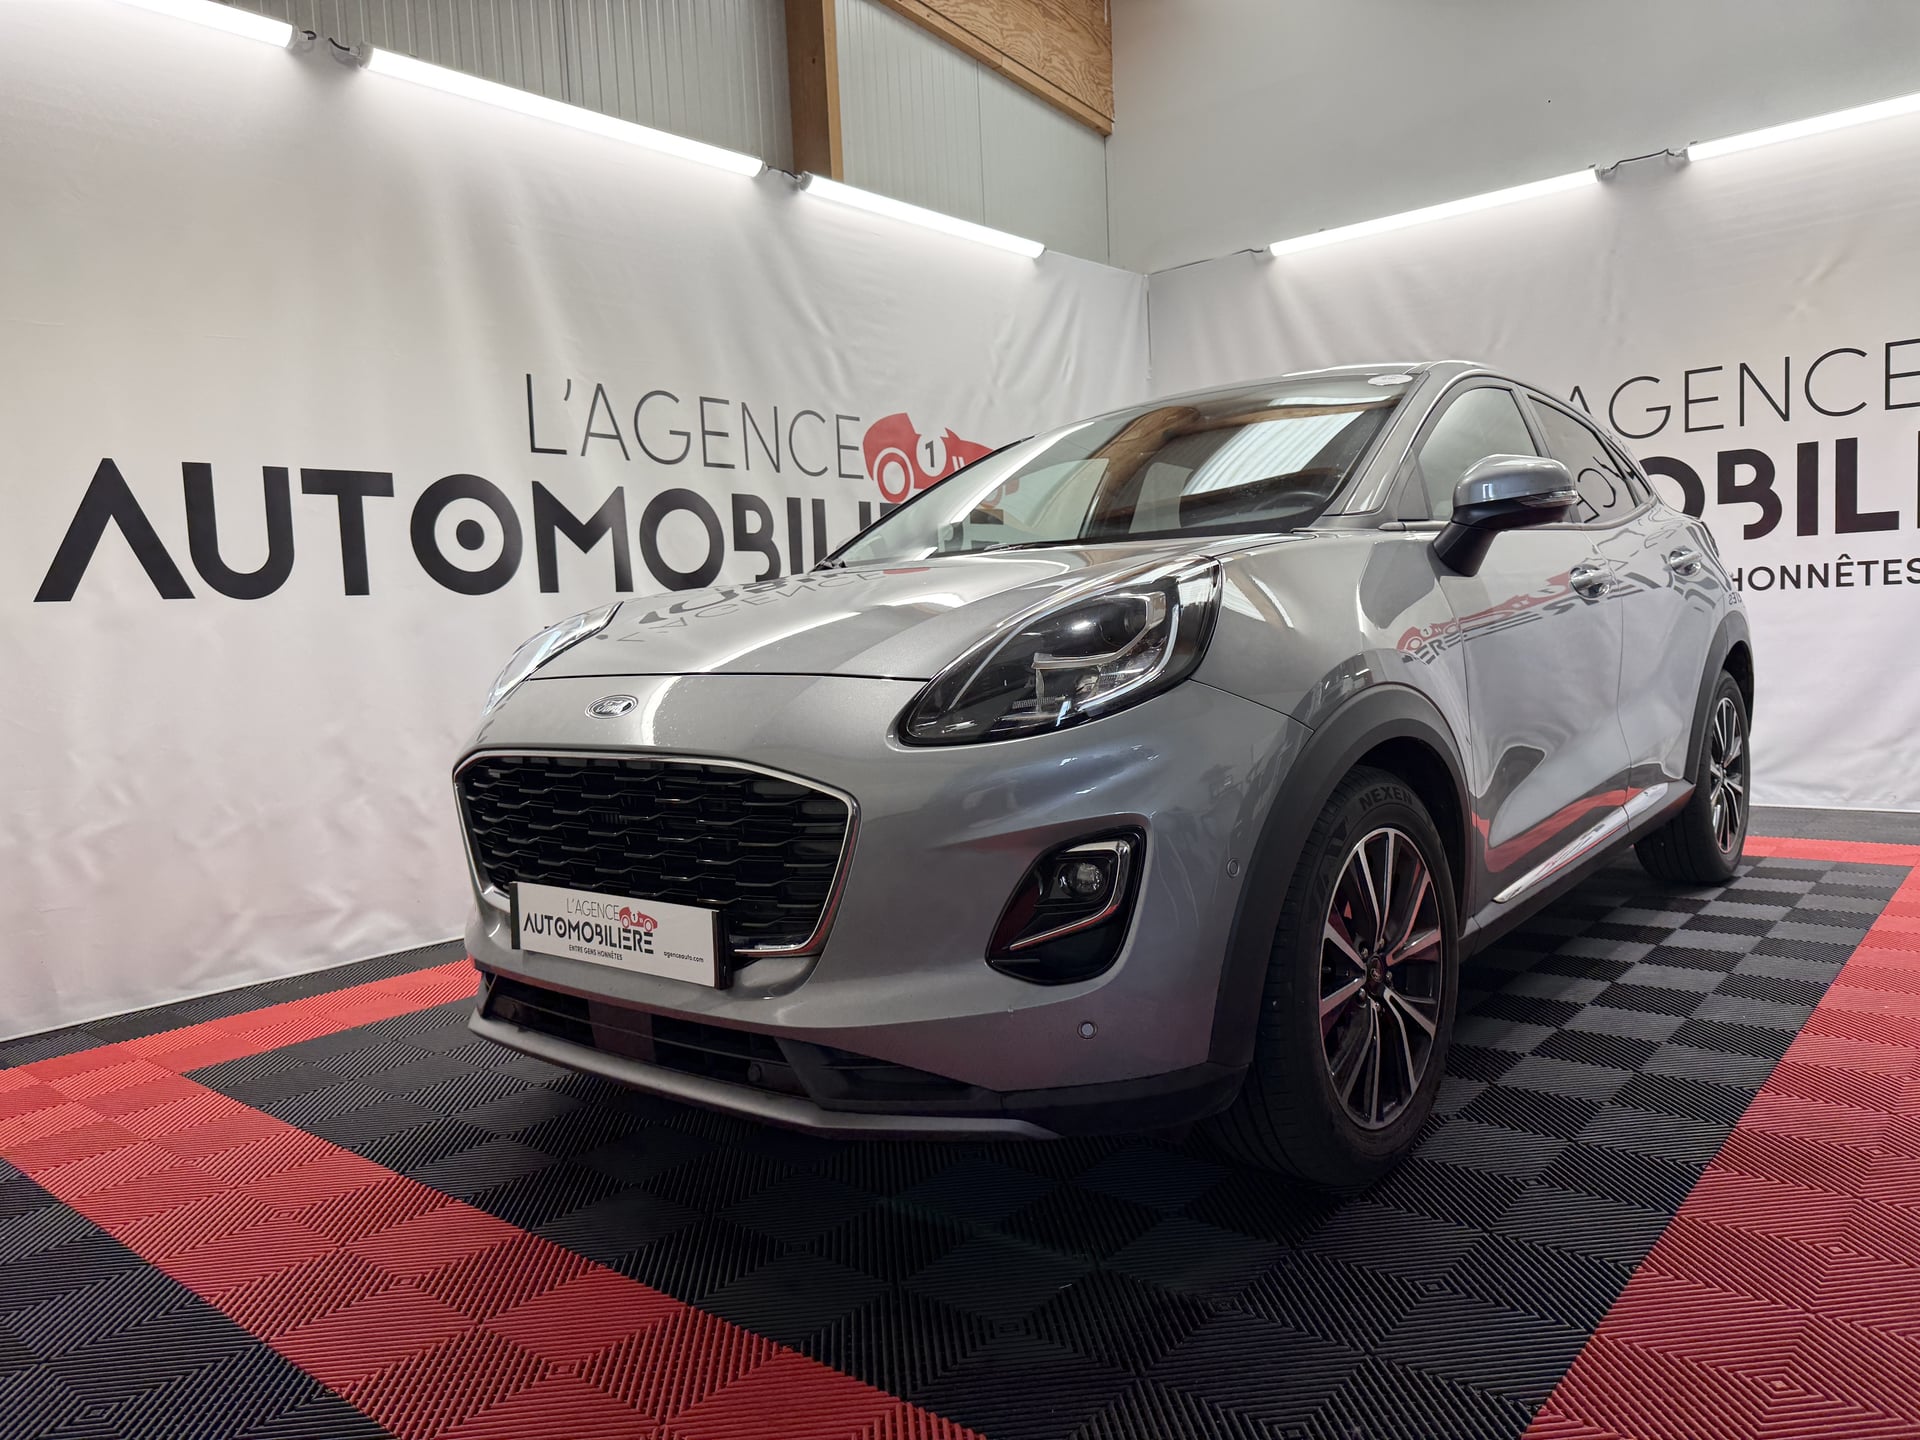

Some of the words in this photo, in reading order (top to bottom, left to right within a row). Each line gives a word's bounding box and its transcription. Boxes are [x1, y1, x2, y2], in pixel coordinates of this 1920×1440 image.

[526, 373, 865, 480] L'AGENCE
[33, 457, 903, 602] AUTOMOBIL
[1359, 786, 1413, 811] NEXEN
[566, 898, 620, 921] L'AGENCE
[584, 947, 597, 956] GENS
